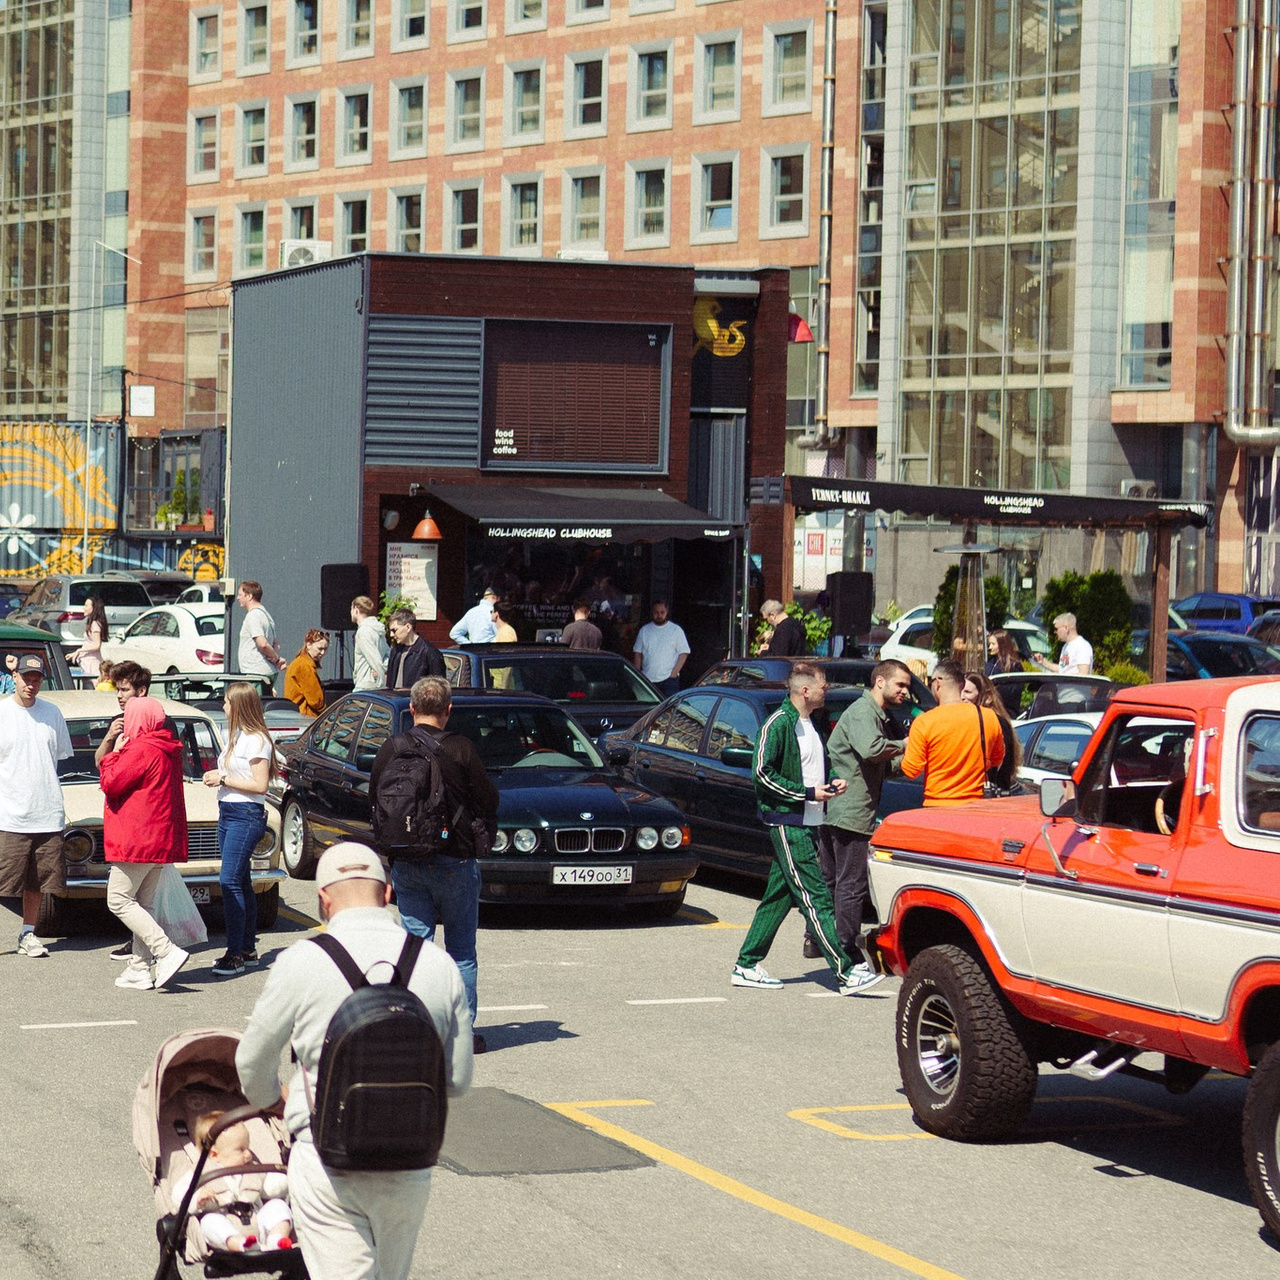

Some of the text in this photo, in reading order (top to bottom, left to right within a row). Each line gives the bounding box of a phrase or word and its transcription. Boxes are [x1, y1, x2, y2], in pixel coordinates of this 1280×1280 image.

[495, 429, 514, 438] food
[495, 437, 514, 445] wine
[493, 446, 518, 455] coffee
[983, 495, 1045, 508] HOLLINGSHEAD
[488, 527, 613, 539] HOLLINGSHEAD CLUBHOUSE
[616, 868, 629, 878] 31
